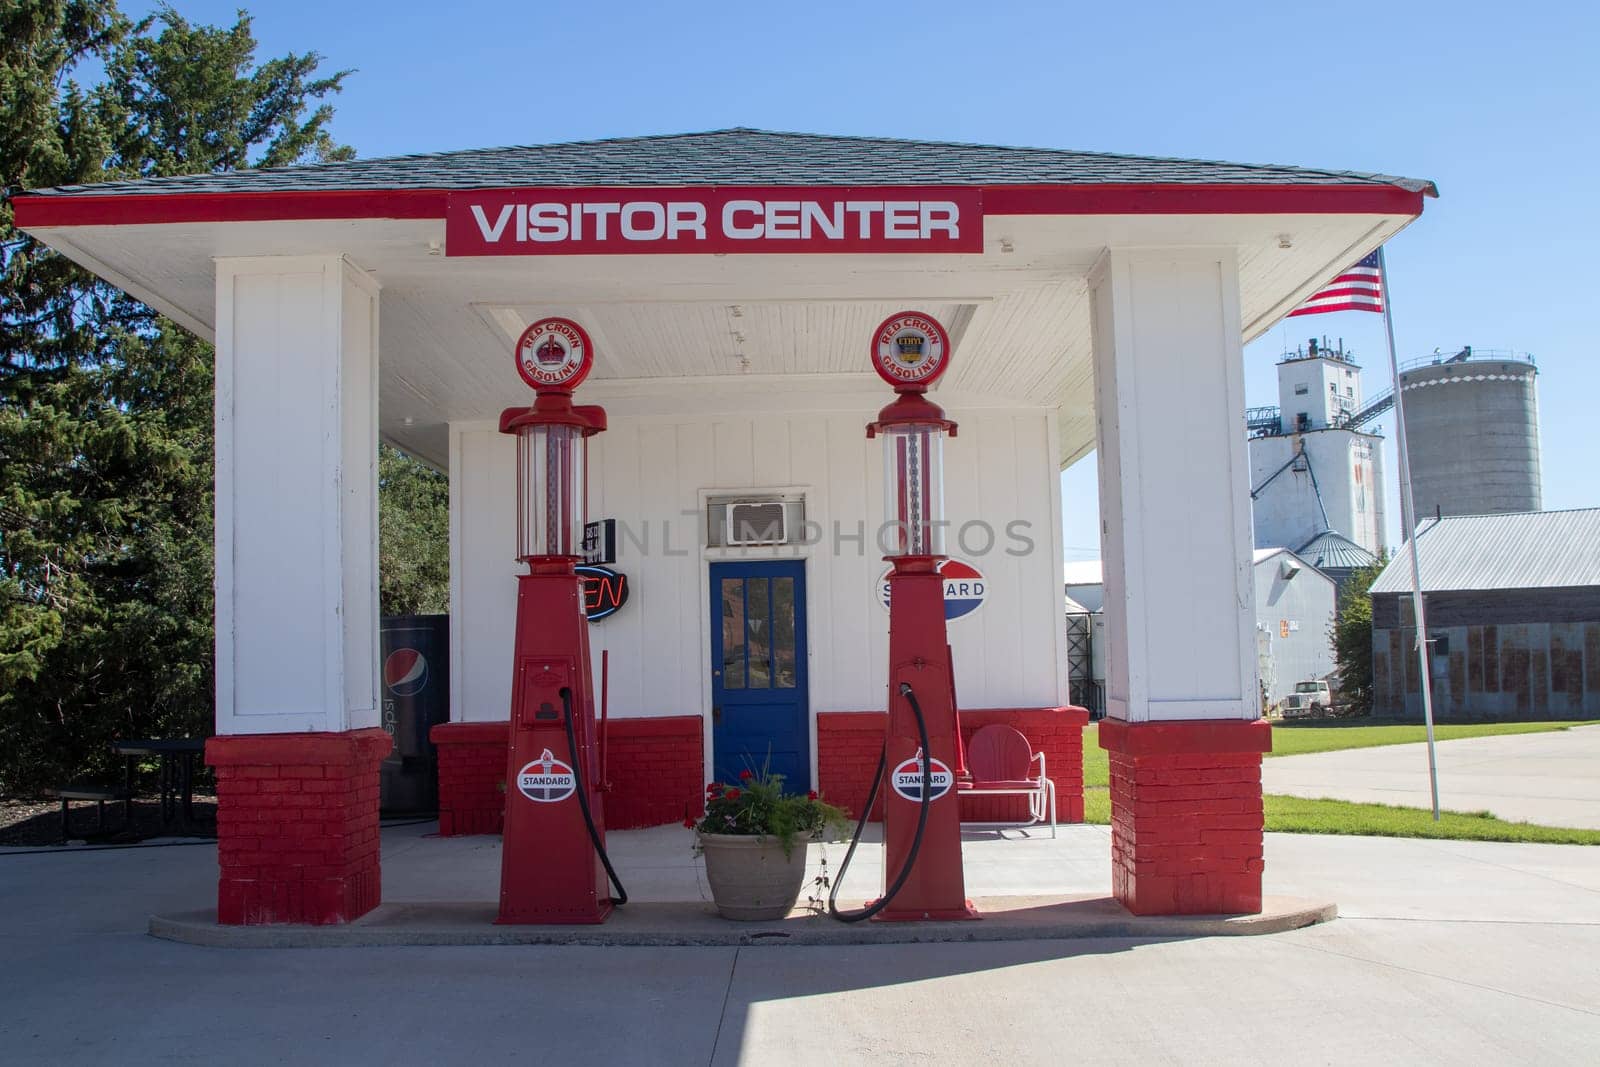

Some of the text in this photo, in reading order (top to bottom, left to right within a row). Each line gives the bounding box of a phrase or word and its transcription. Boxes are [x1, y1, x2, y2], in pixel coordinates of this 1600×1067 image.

[470, 200, 961, 243] VISITOR CENTER
[523, 323, 581, 349] RED CROWN
[881, 318, 940, 345] RED CROWN
[525, 359, 578, 381] GASOLINE
[883, 355, 938, 378] GASOLINE
[583, 575, 625, 609] EN
[883, 582, 985, 598] SARD
[523, 776, 571, 786] STANDARD
